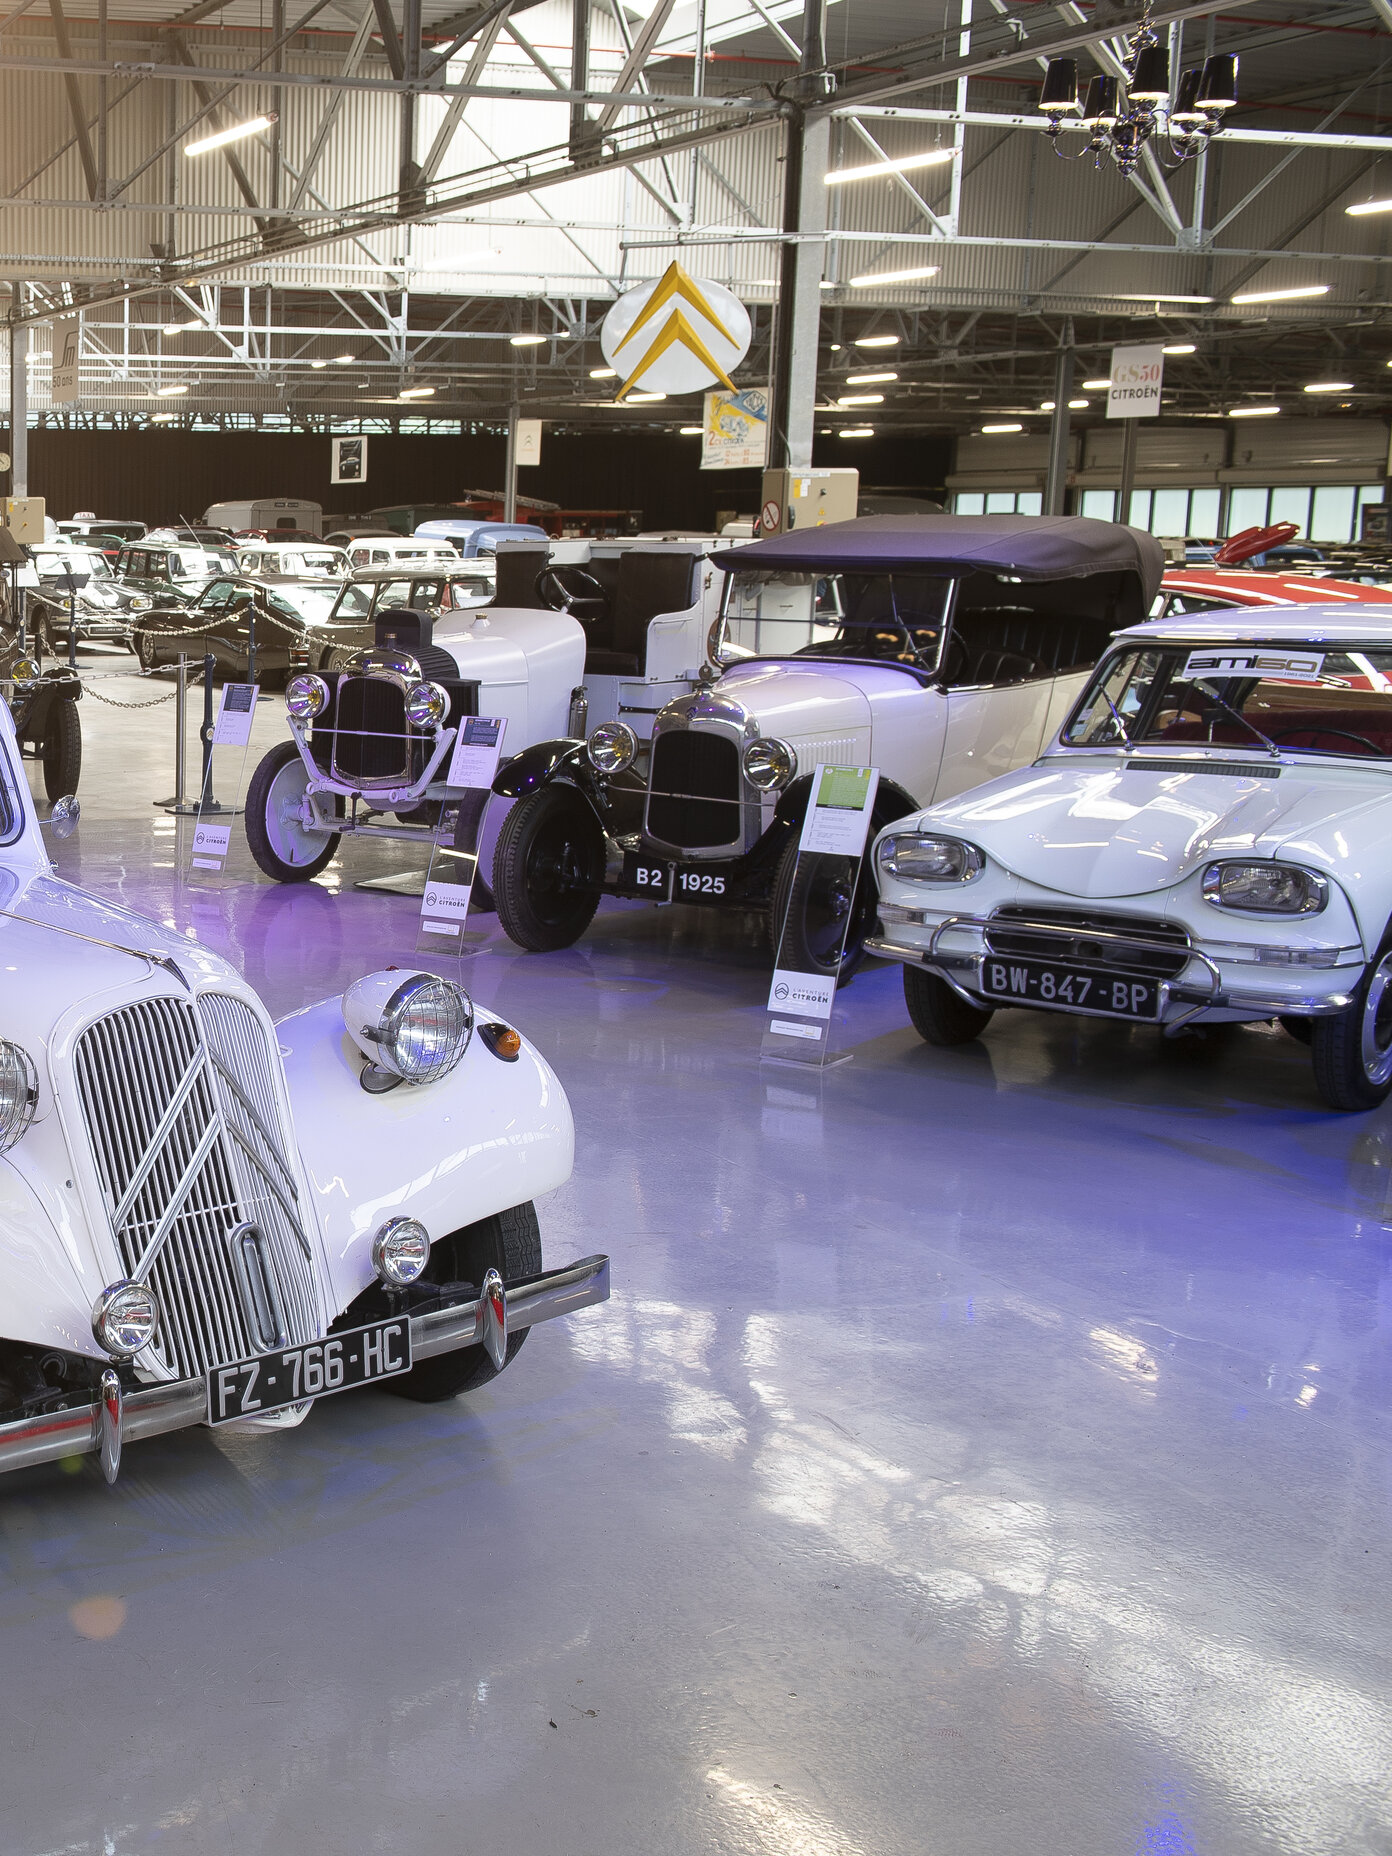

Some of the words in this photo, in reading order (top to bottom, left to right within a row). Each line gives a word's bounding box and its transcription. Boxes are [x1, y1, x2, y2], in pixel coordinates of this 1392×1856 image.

[62, 375, 73, 387] ans
[1111, 384, 1159, 399] CITROËN
[636, 867, 663, 887] B2
[679, 873, 726, 895] 1925
[438, 899, 466, 908] CITROËN
[792, 988, 830, 997] L'AVENTURE
[791, 993, 829, 1004] CITROËN
